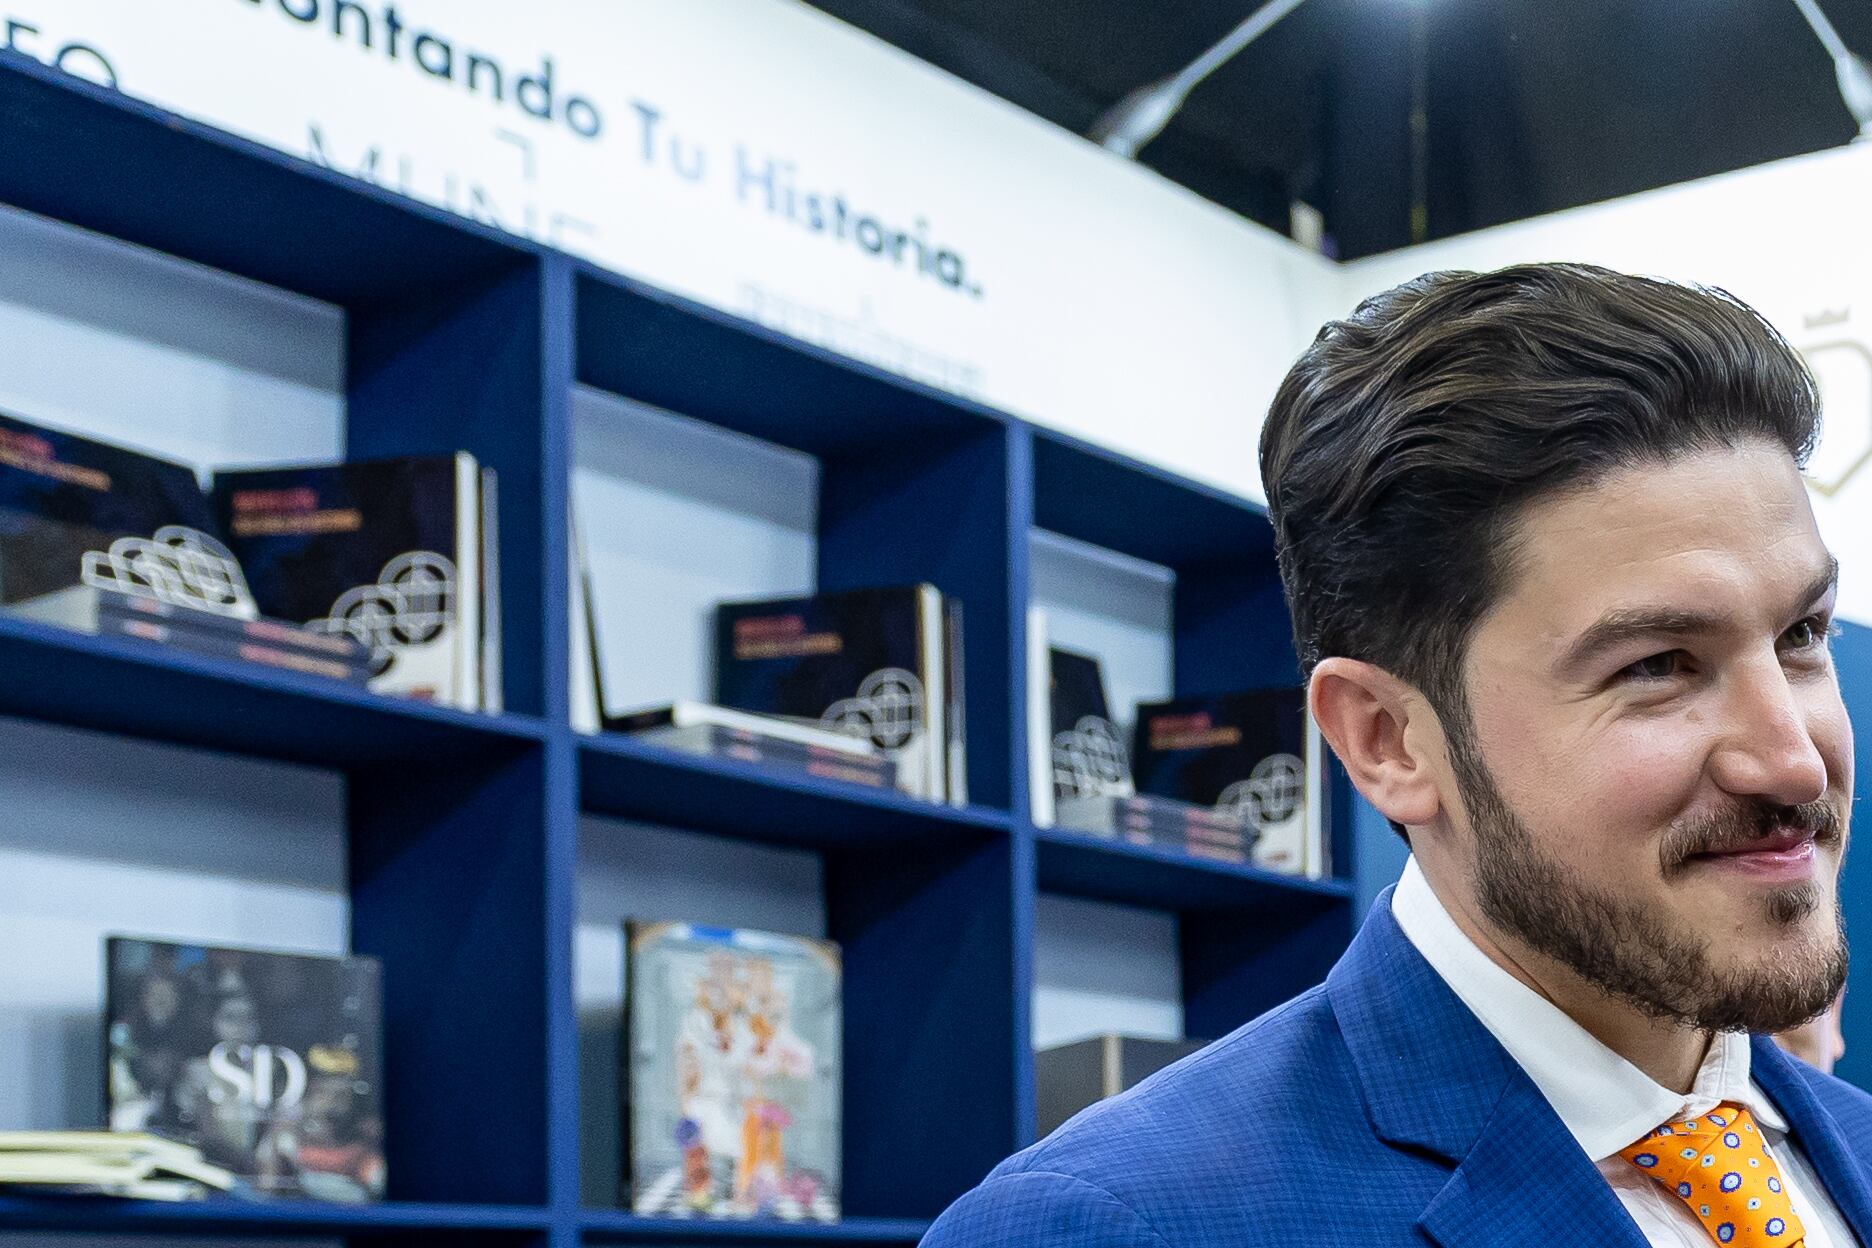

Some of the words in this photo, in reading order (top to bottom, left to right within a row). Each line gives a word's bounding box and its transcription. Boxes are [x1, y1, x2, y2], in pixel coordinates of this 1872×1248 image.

[240, 0, 604, 139] ontando
[631, 100, 707, 183] Tu
[734, 141, 986, 300] Historia.
